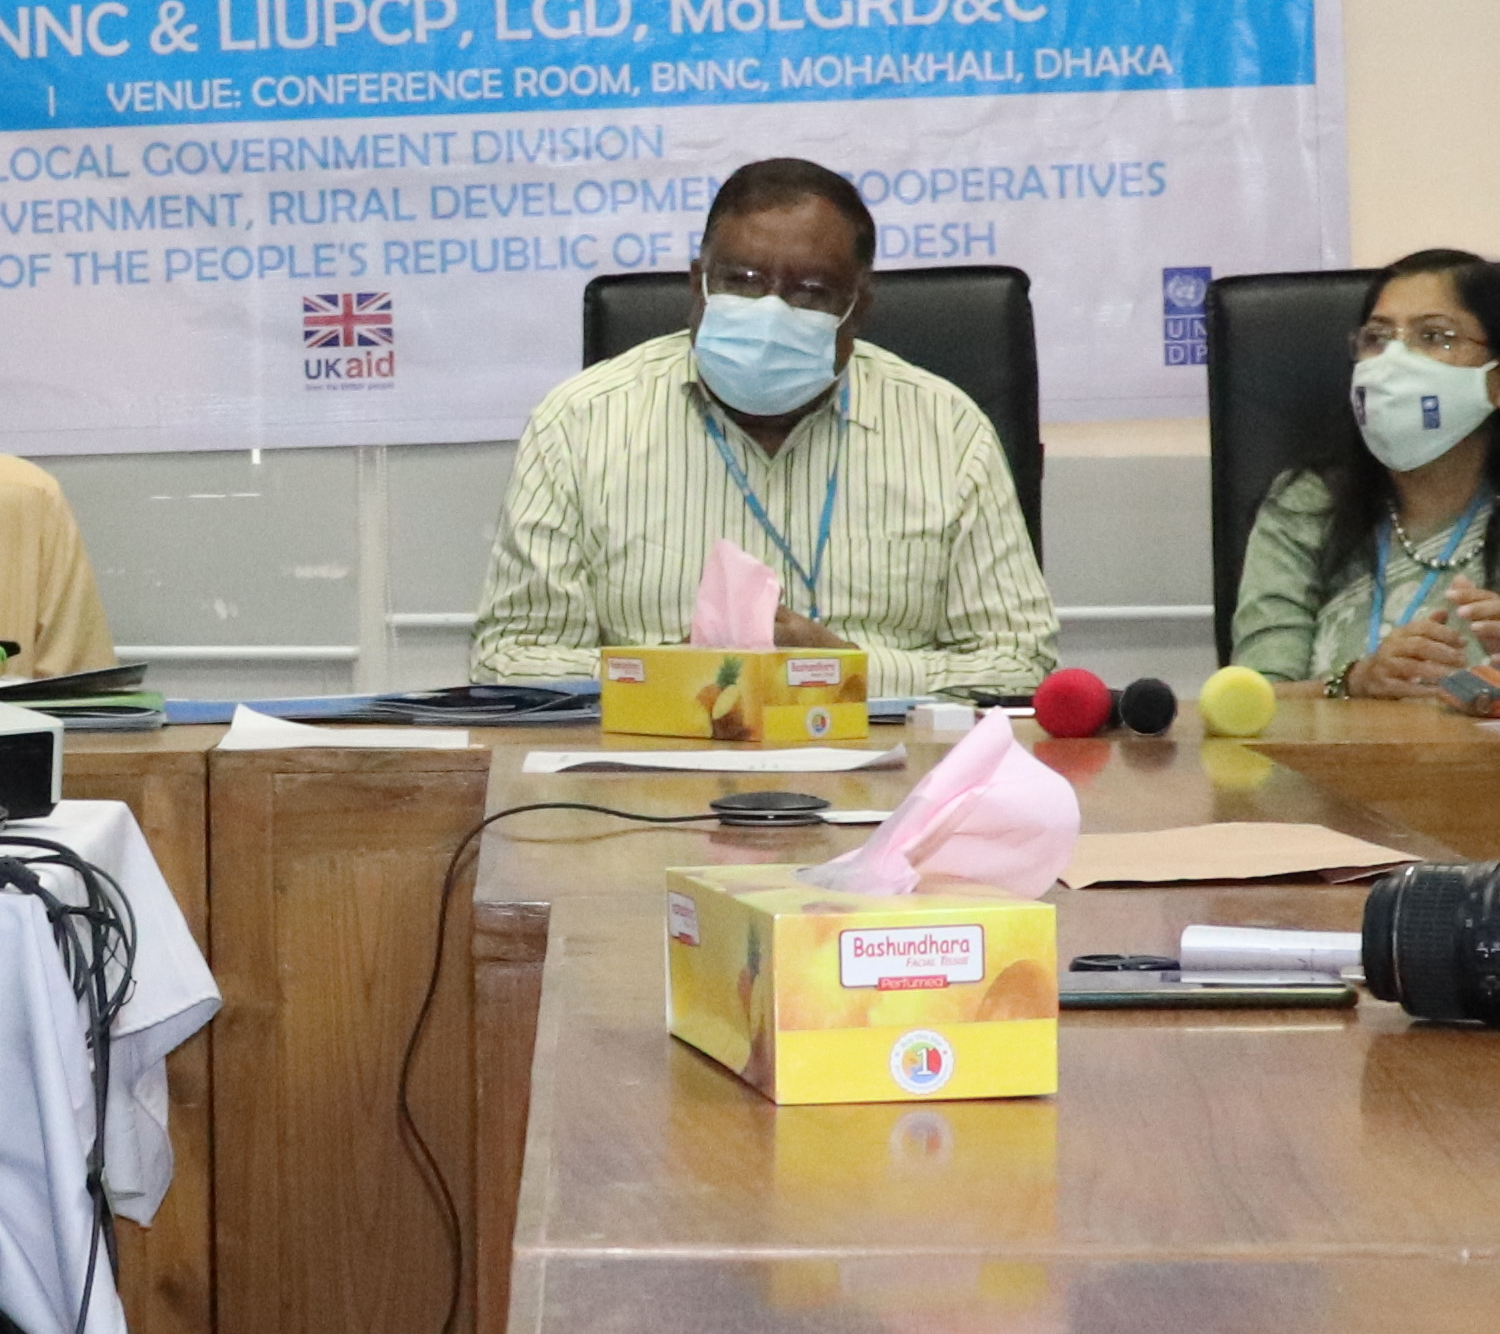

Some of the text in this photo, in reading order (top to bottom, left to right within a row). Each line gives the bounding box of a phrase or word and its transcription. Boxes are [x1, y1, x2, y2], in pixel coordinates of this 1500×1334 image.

[148, 0, 200, 56] &
[107, 77, 244, 112] VENUE:
[252, 66, 501, 107] CONFERENCE
[515, 62, 640, 98] ROOM,
[651, 58, 768, 94] BNNC,
[781, 49, 1024, 87] MOHAKHALI,
[1035, 43, 1175, 77] DHAKA
[143, 132, 456, 176] GOVERNMENT
[473, 126, 663, 164] DIVISION
[268, 186, 416, 225] RURAL
[430, 175, 722, 220] DEVELOPME
[64, 249, 150, 286] THE
[165, 241, 367, 282] PEOPLE'S
[384, 234, 597, 275] REPUBLIC
[612, 232, 672, 268] OF
[853, 933, 970, 958] Bashundhara
[880, 976, 944, 990] Perfumed
[916, 1047, 933, 1076] 1
